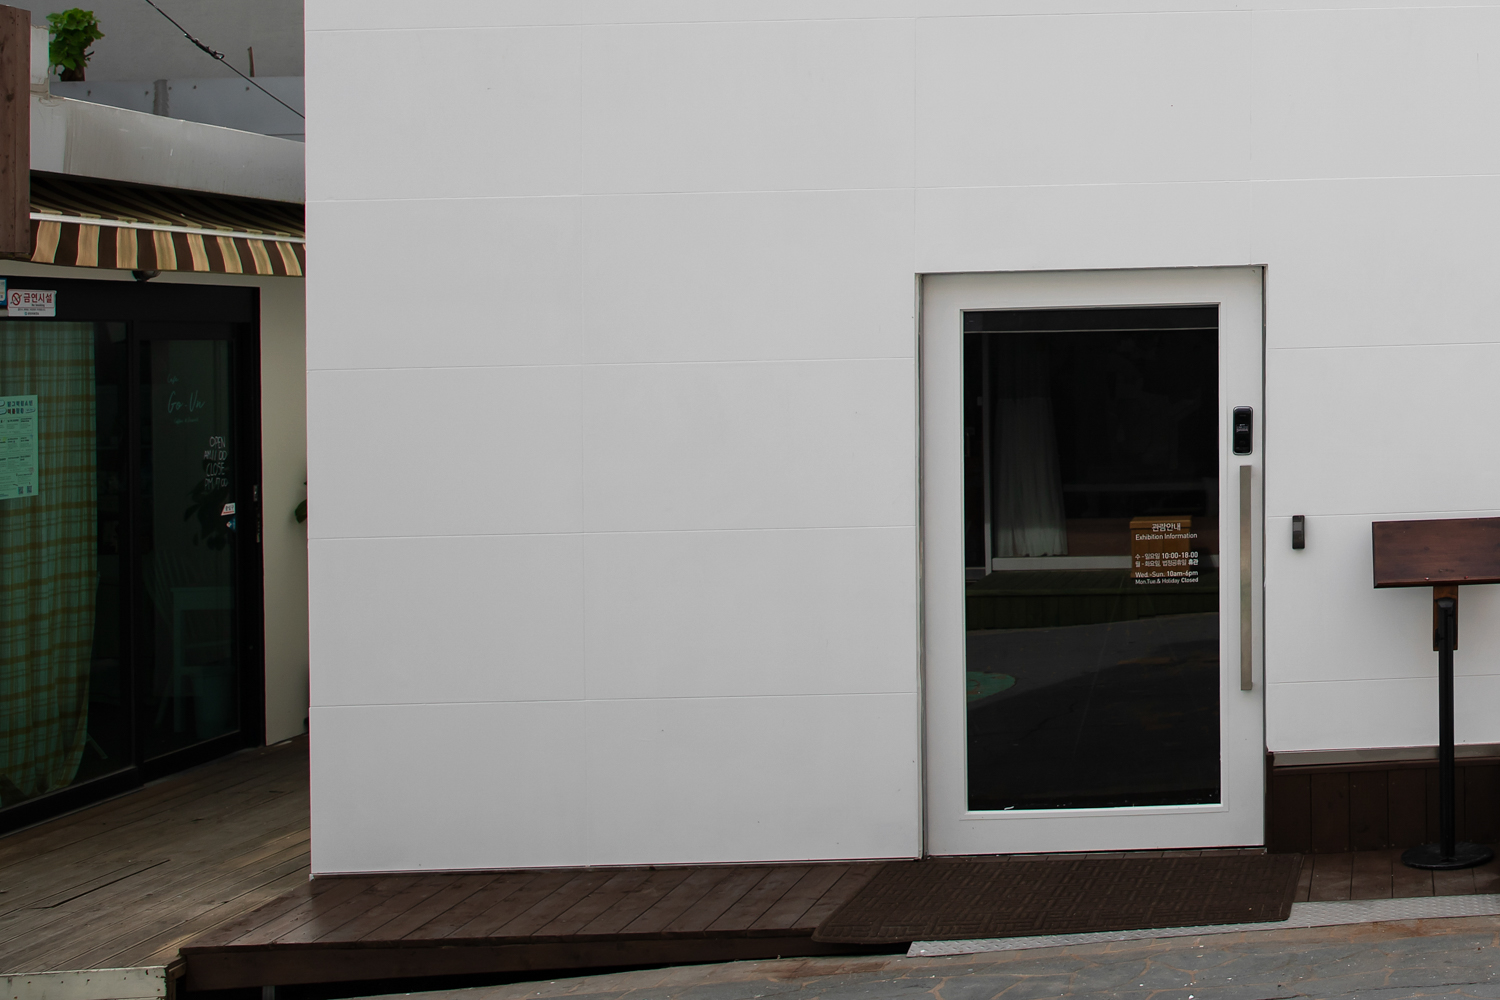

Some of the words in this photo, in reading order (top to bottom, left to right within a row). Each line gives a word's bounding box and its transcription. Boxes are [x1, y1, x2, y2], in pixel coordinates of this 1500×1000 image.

[23, 292, 53, 304] 금연시설
[209, 436, 226, 449] OPEN
[206, 462, 226, 477] CLOSE
[1151, 522, 1181, 532] 관람안내
[1135, 533, 1163, 541] Exhibition
[1164, 532, 1198, 540] Information
[1188, 558, 1199, 566] 휴관
[1166, 569, 1198, 577] 10am-6pm
